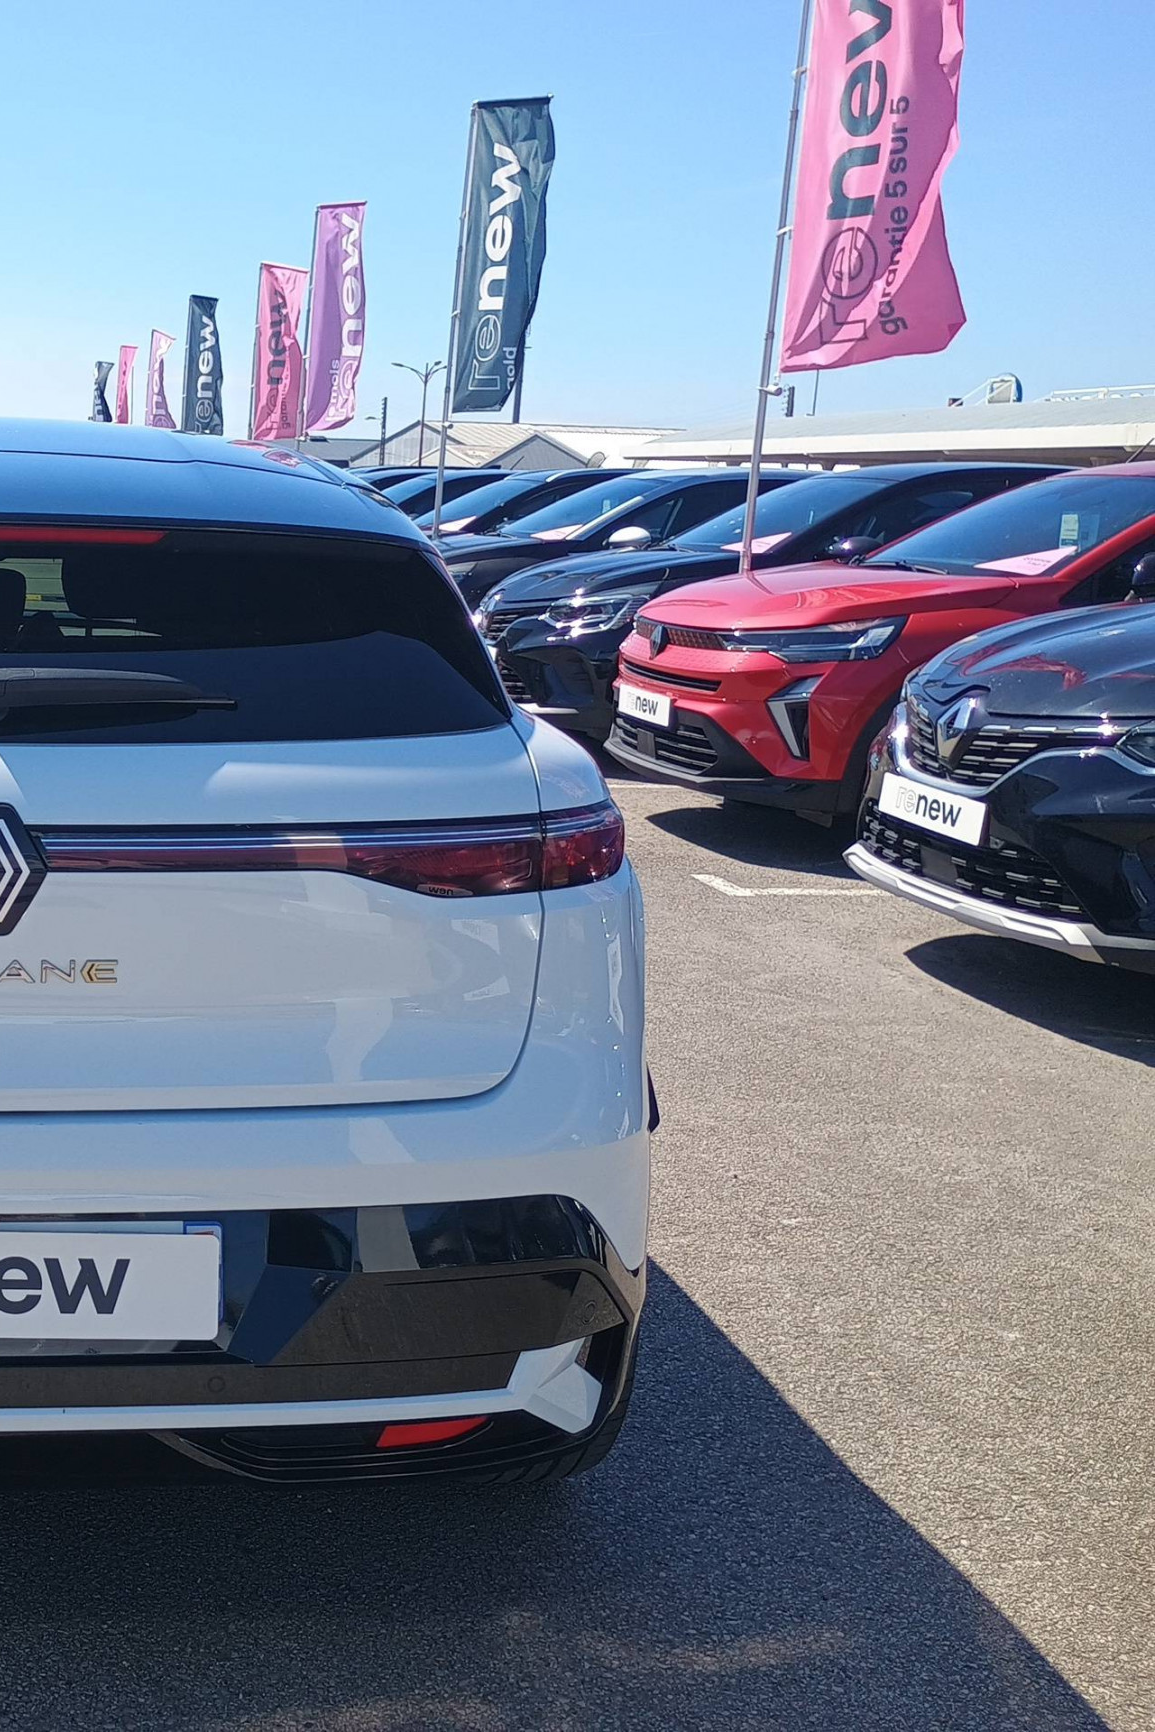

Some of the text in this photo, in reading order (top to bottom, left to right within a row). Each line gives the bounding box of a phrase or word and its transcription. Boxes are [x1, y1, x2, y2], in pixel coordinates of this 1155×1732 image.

[468, 143, 522, 391] renew
[879, 96, 910, 335] garantie 5 sur 5
[895, 786, 963, 828] renew
